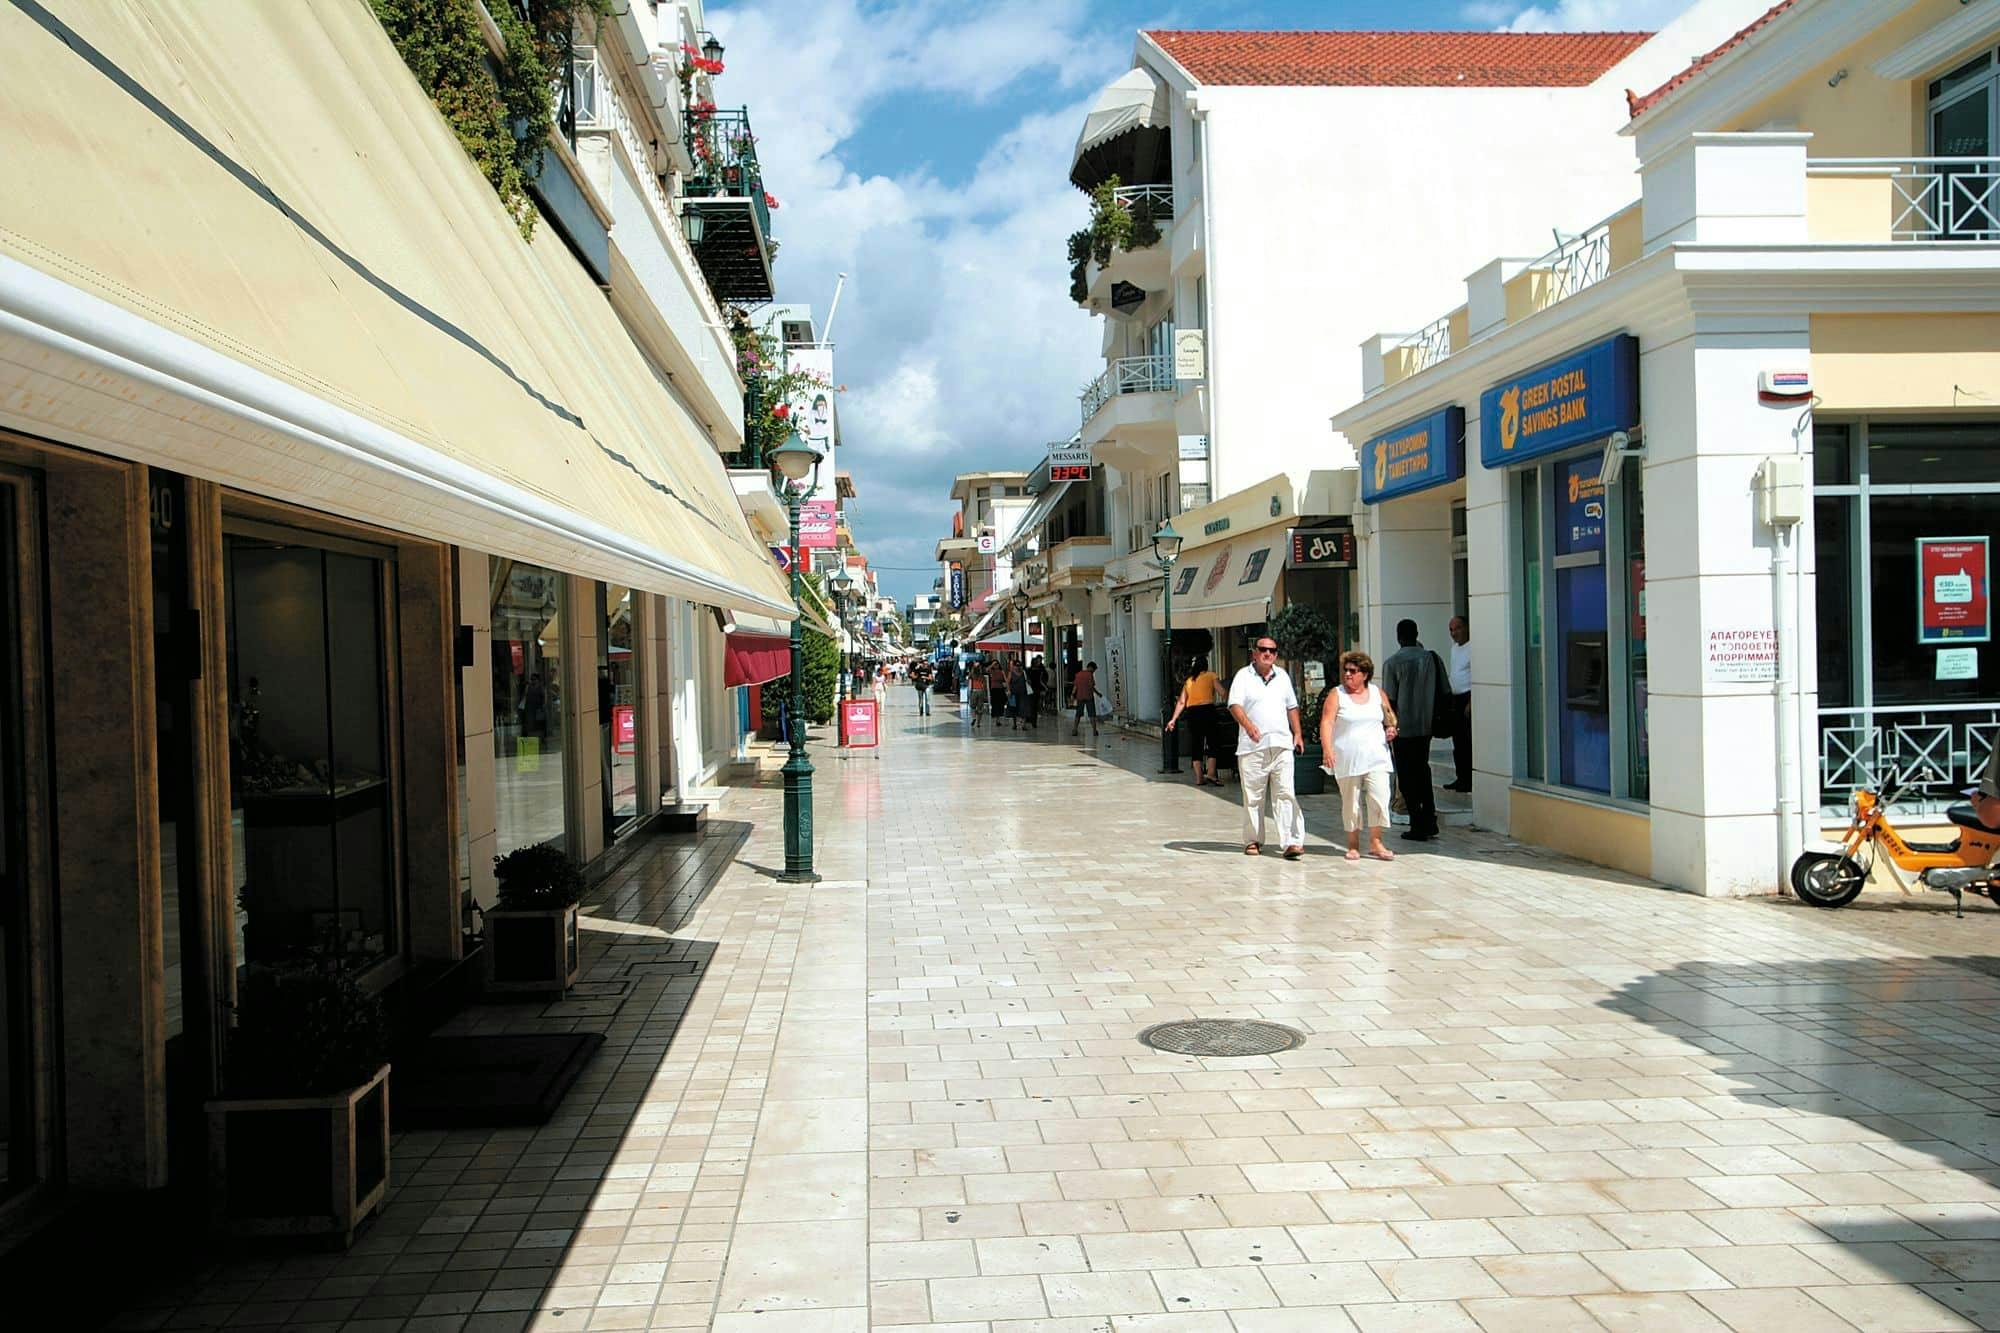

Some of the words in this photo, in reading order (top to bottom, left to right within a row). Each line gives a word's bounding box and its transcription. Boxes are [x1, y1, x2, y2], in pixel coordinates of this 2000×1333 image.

[1522, 383, 1549, 410] GREEK
[1551, 369, 1586, 400] POSTAL
[1522, 406, 1558, 438] SAVINGS
[1561, 396, 1586, 424] BANK
[1052, 453, 1089, 461] MESSARIS
[1110, 649, 1121, 707] MESSARIS
